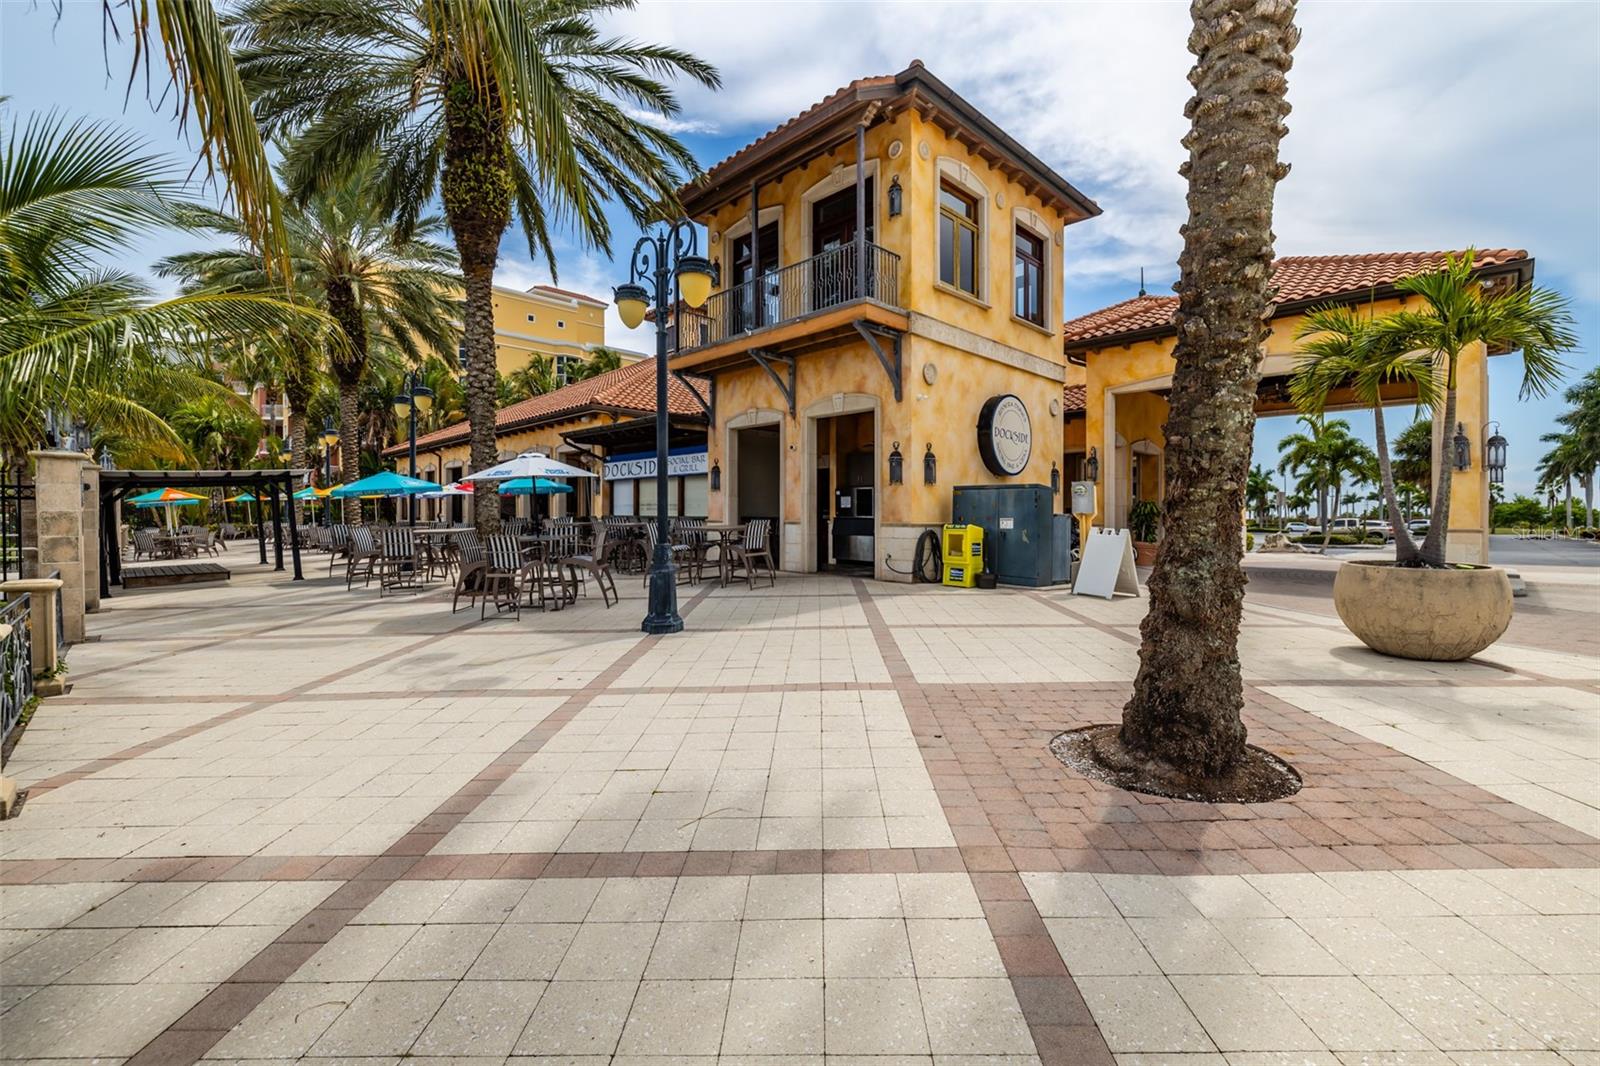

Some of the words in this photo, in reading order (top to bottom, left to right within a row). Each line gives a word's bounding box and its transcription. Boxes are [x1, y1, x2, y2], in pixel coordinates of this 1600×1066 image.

[691, 455, 705, 464] BAR
[604, 460, 657, 478] DOCKSID
[679, 464, 699, 472] GRILL
